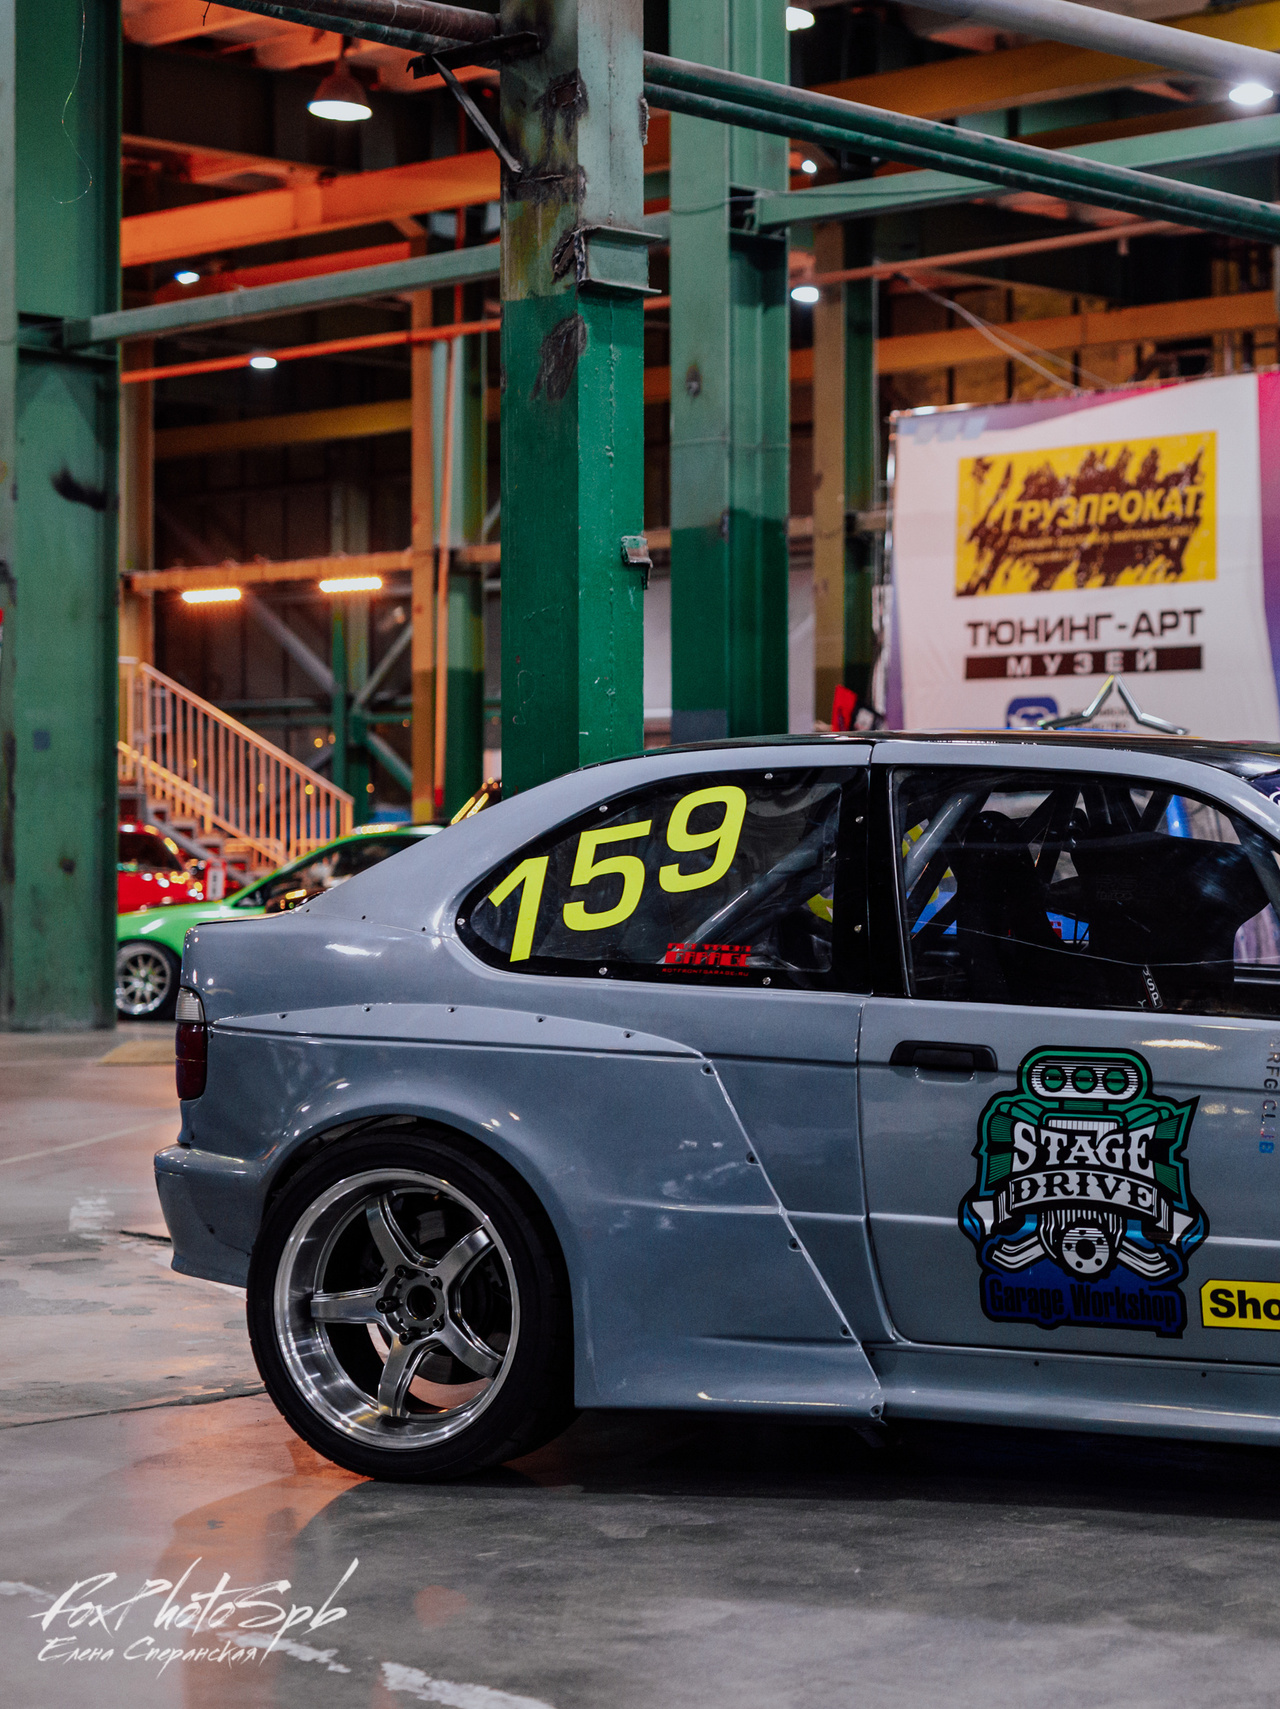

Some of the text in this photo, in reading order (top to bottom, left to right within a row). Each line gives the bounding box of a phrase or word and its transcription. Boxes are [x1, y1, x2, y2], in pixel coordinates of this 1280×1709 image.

[1001, 485, 1204, 533] ГРУЗПРОКАТ
[967, 608, 1203, 647] ТЮНИНГ-АРТ
[1006, 648, 1158, 678] МУЗЕЙ
[488, 785, 747, 962] 159
[1012, 1120, 1156, 1182] STAGE
[1013, 1171, 1154, 1209] DRIVE
[989, 1281, 1177, 1328] Garage Workshop
